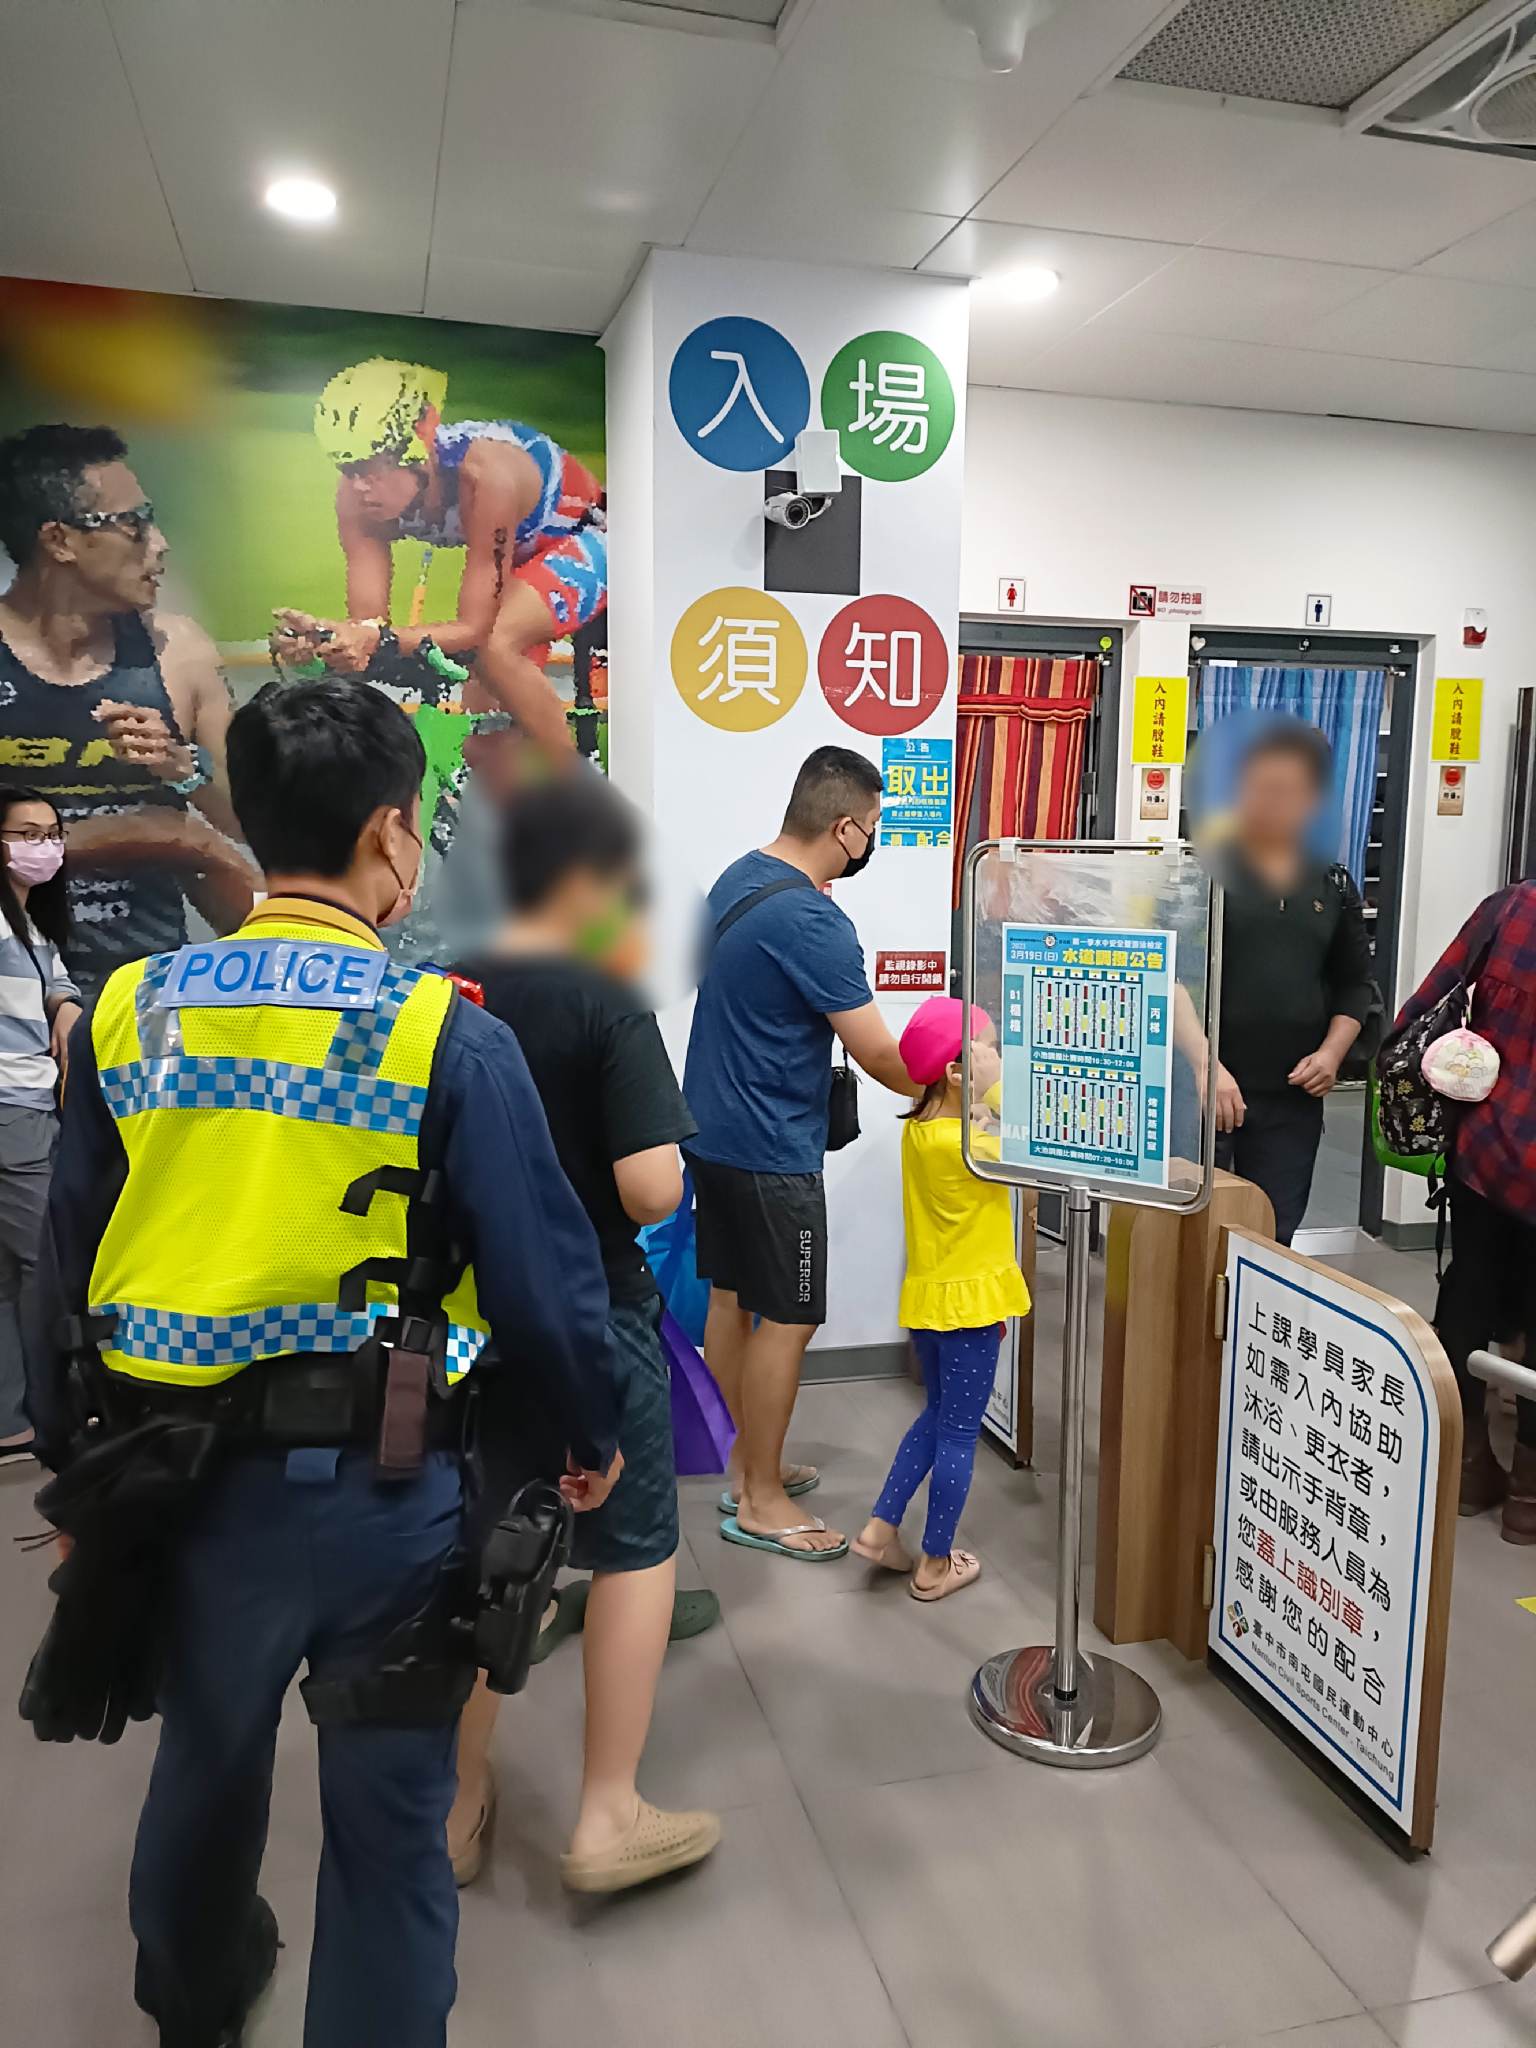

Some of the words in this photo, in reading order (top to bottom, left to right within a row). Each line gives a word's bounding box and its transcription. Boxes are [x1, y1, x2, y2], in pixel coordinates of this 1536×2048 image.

[697, 350, 930, 454] 入場
[697, 615, 922, 708] 須知
[1151, 681, 1167, 757] 入內請脫鞋
[1449, 682, 1464, 755] 入內請脫鞋
[887, 765, 949, 795] 取出
[178, 951, 370, 995] POLICE
[884, 959, 937, 971] 監視錄影中
[1245, 1342, 1403, 1464] 如需入內協助
[1248, 1302, 1405, 1416] 上課學員家長
[1239, 1472, 1391, 1612] 或由服務人員為
[1235, 1557, 1386, 1706] 感謝您的配合
[1251, 1618, 1394, 1758] 臺中市南屯國民運動中心
[1278, 1666, 1295, 1687] Civil
[1296, 1682, 1320, 1712] Sports
[1322, 1706, 1350, 1738] Center
[1356, 1736, 1395, 1783] Taichung
